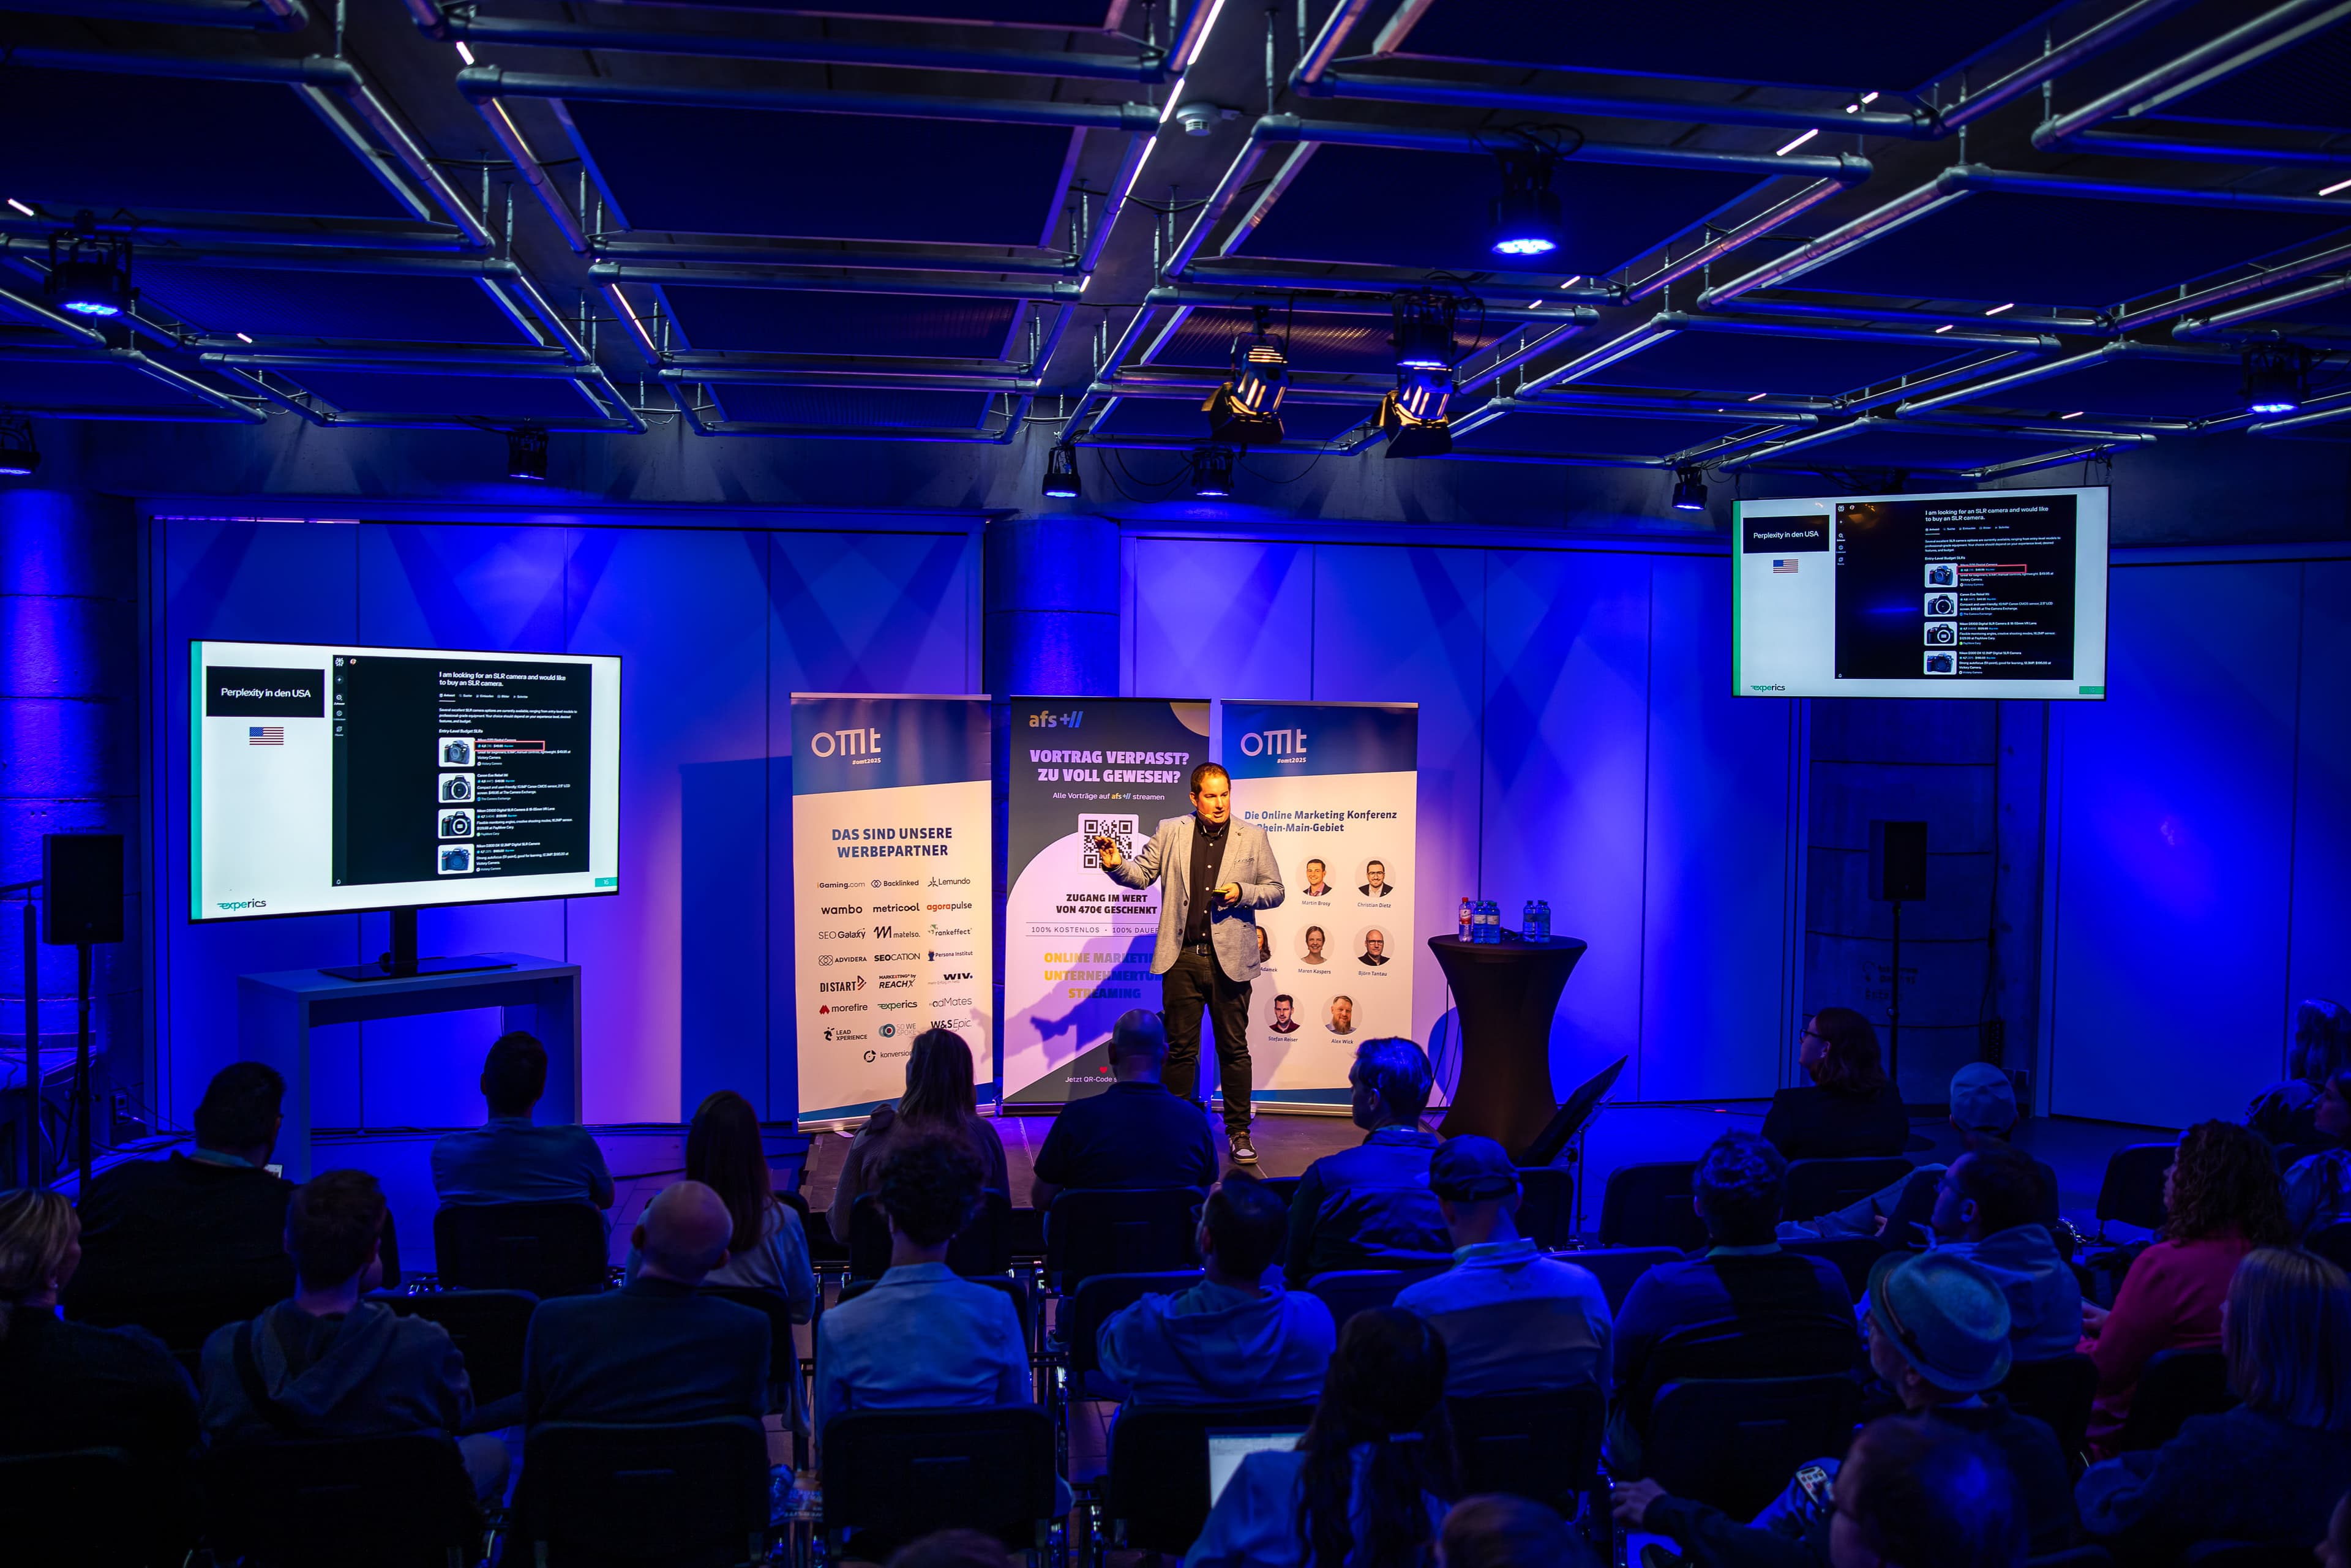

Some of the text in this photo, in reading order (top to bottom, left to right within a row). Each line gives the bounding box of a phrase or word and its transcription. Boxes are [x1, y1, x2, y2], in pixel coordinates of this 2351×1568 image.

[221, 688, 264, 699] Perplexity
[1030, 750, 1190, 765] VORTRAG VERPASST?
[1038, 768, 1181, 784] ZU VOLL GEWESEN?
[1245, 810, 1397, 821] Die Online Marketing Konferenz
[832, 828, 952, 841] DAS SIND UNSERE
[838, 845, 948, 858] WERBEPARTNER
[217, 899, 266, 910] experics
[821, 904, 863, 915] wambo
[873, 903, 920, 913] metricool
[927, 901, 972, 912] agorapulse
[1104, 906, 1157, 915] GESCHENKT
[838, 928, 866, 940] Galaxy
[874, 953, 920, 961] SEOCATION
[1044, 953, 1090, 963] ONLINE
[820, 981, 856, 992] DISTART
[879, 978, 915, 988] REACHX
[1068, 988, 1141, 999] STREAMING
[831, 1003, 868, 1013] morefire
[877, 1000, 918, 1010] experics
[932, 997, 972, 1008] adMates
[931, 1018, 972, 1030] W&S Epic
